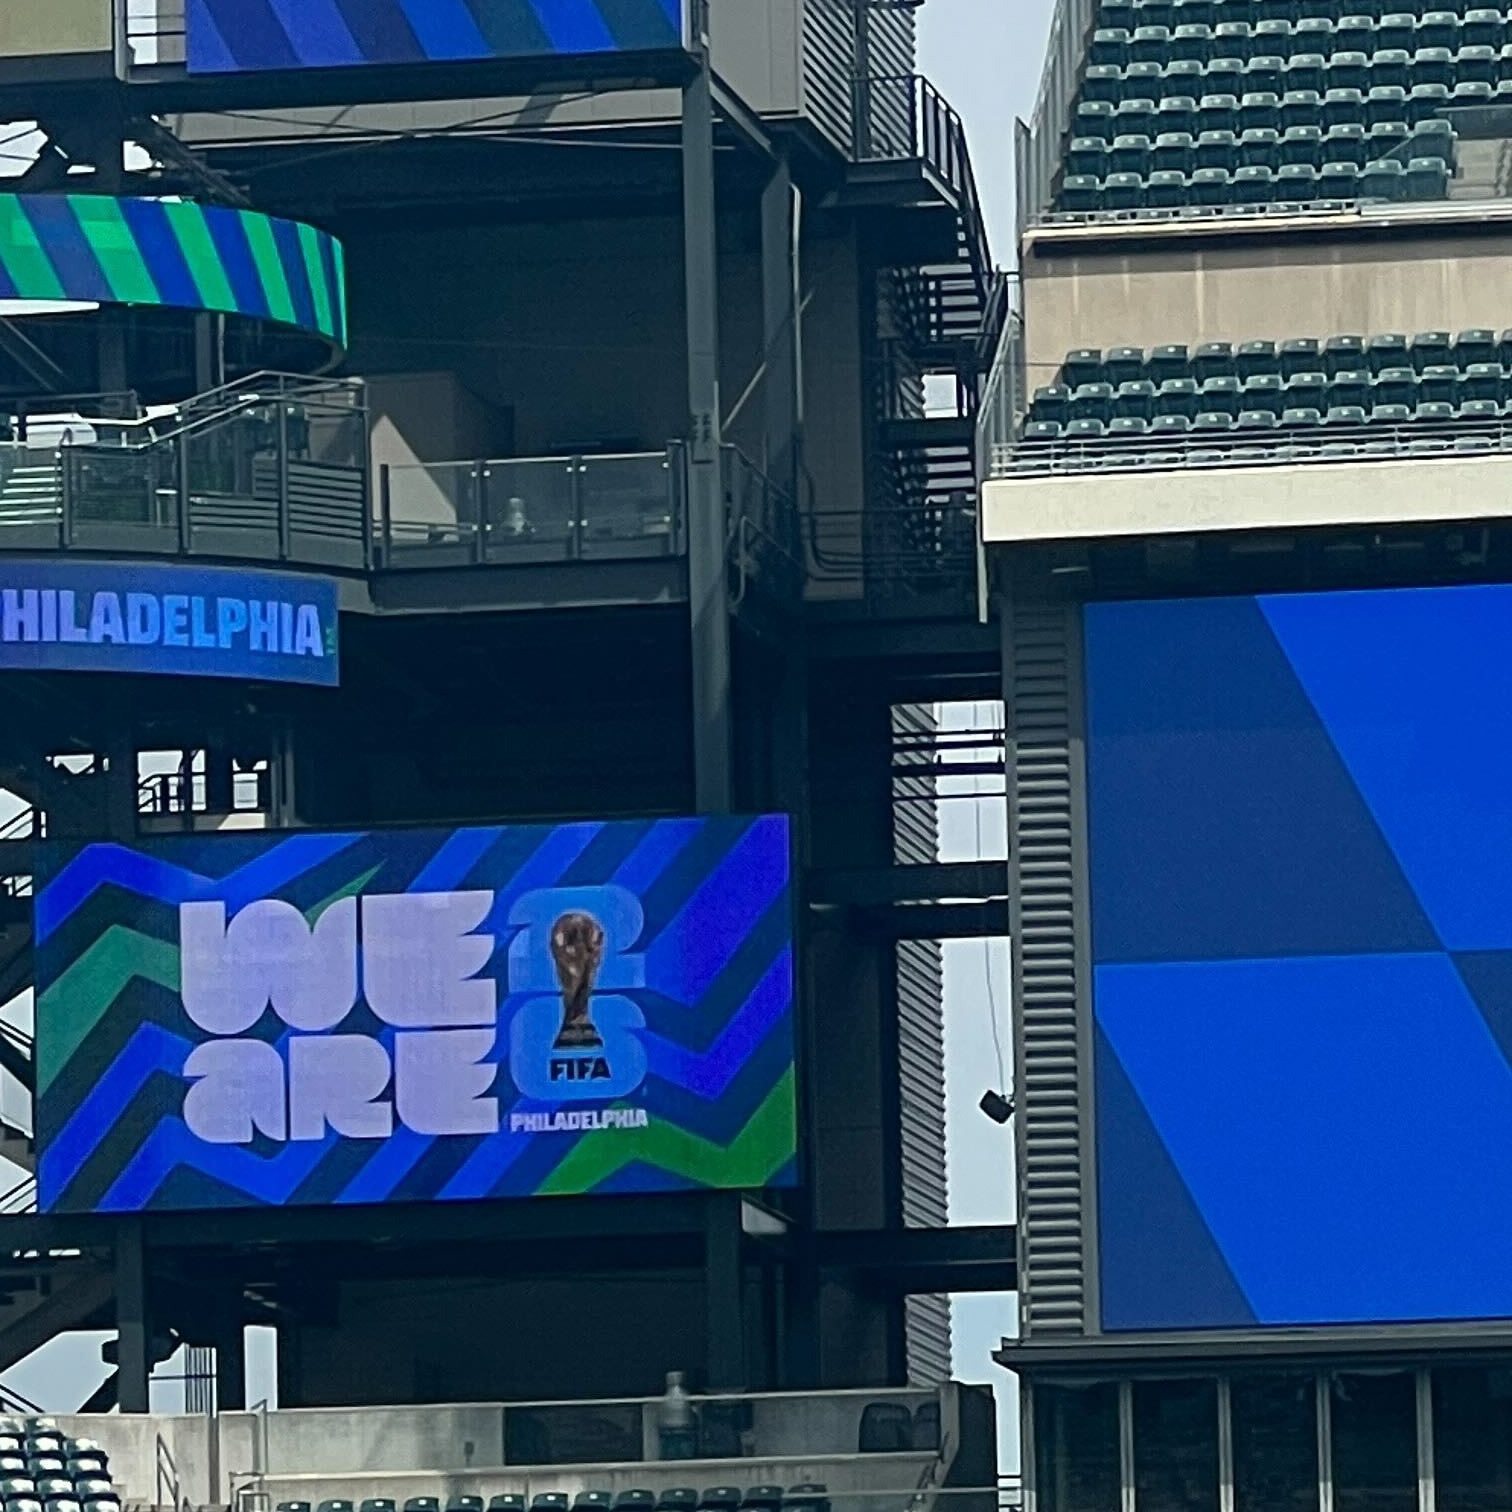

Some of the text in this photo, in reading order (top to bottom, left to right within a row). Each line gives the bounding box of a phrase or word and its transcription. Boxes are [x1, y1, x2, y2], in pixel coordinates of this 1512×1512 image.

[180, 889, 498, 1035] WE
[182, 1028, 499, 1144] ARE
[550, 1057, 611, 1081] FIFA
[510, 1108, 649, 1132] PHILADELPHIA
